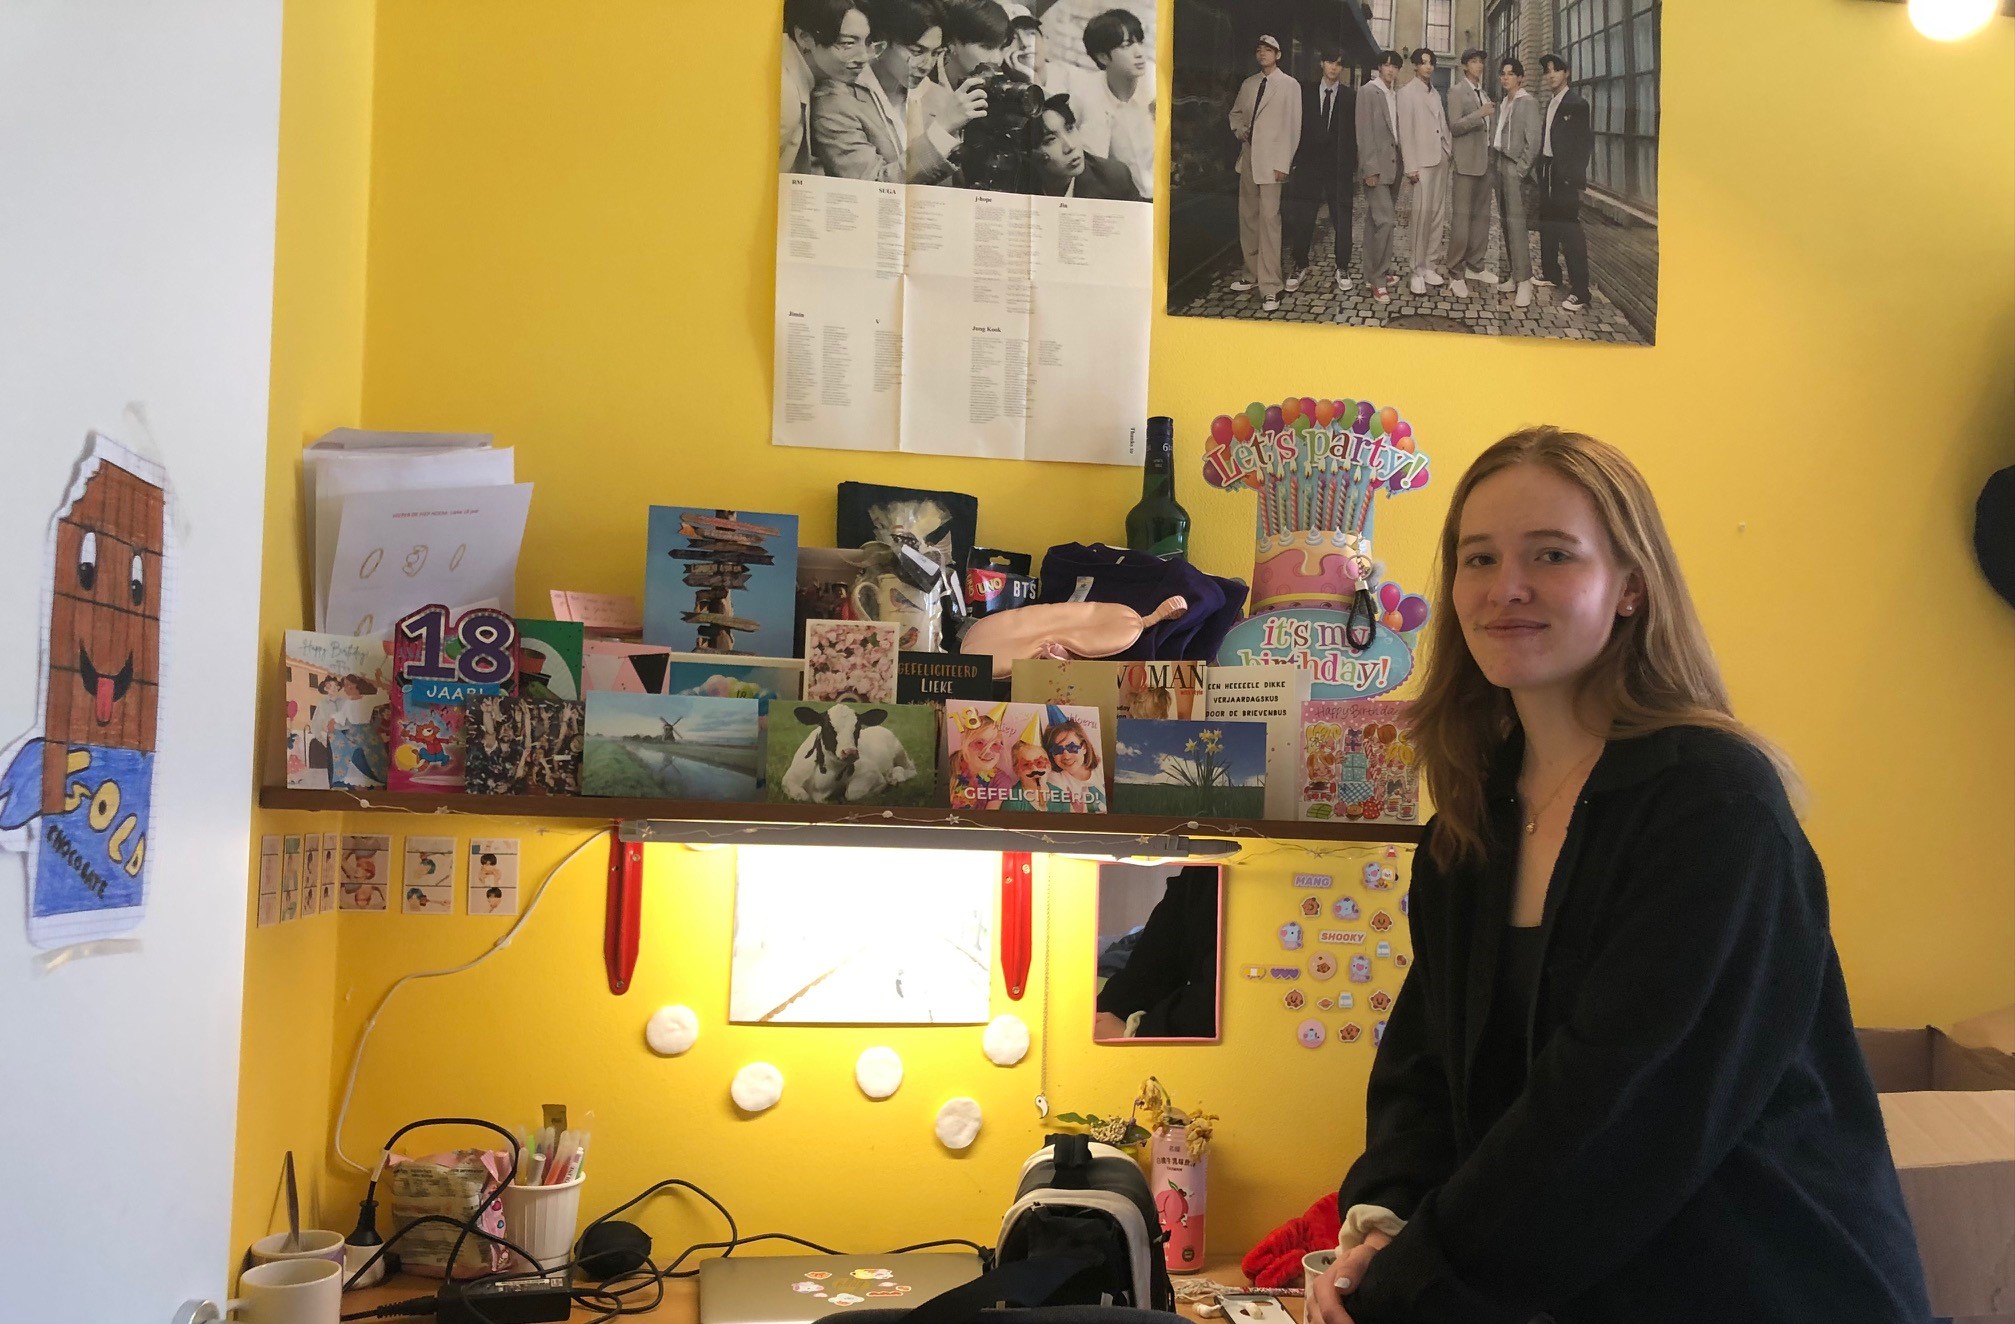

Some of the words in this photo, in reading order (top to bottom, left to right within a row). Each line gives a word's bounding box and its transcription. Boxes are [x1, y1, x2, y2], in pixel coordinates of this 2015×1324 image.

[1206, 430, 1298, 485] Let's
[1302, 429, 1427, 488] party!
[976, 578, 1002, 595] UNO
[1013, 580, 1036, 600] BTS
[401, 607, 515, 684] 18
[1264, 619, 1309, 648] it's
[949, 705, 982, 733] 18
[964, 787, 1100, 806] GEFELICITEERD!
[47, 825, 108, 899] CHOCOLATE
[1295, 876, 1330, 886] MANG
[1321, 932, 1364, 942] SHOOKY
